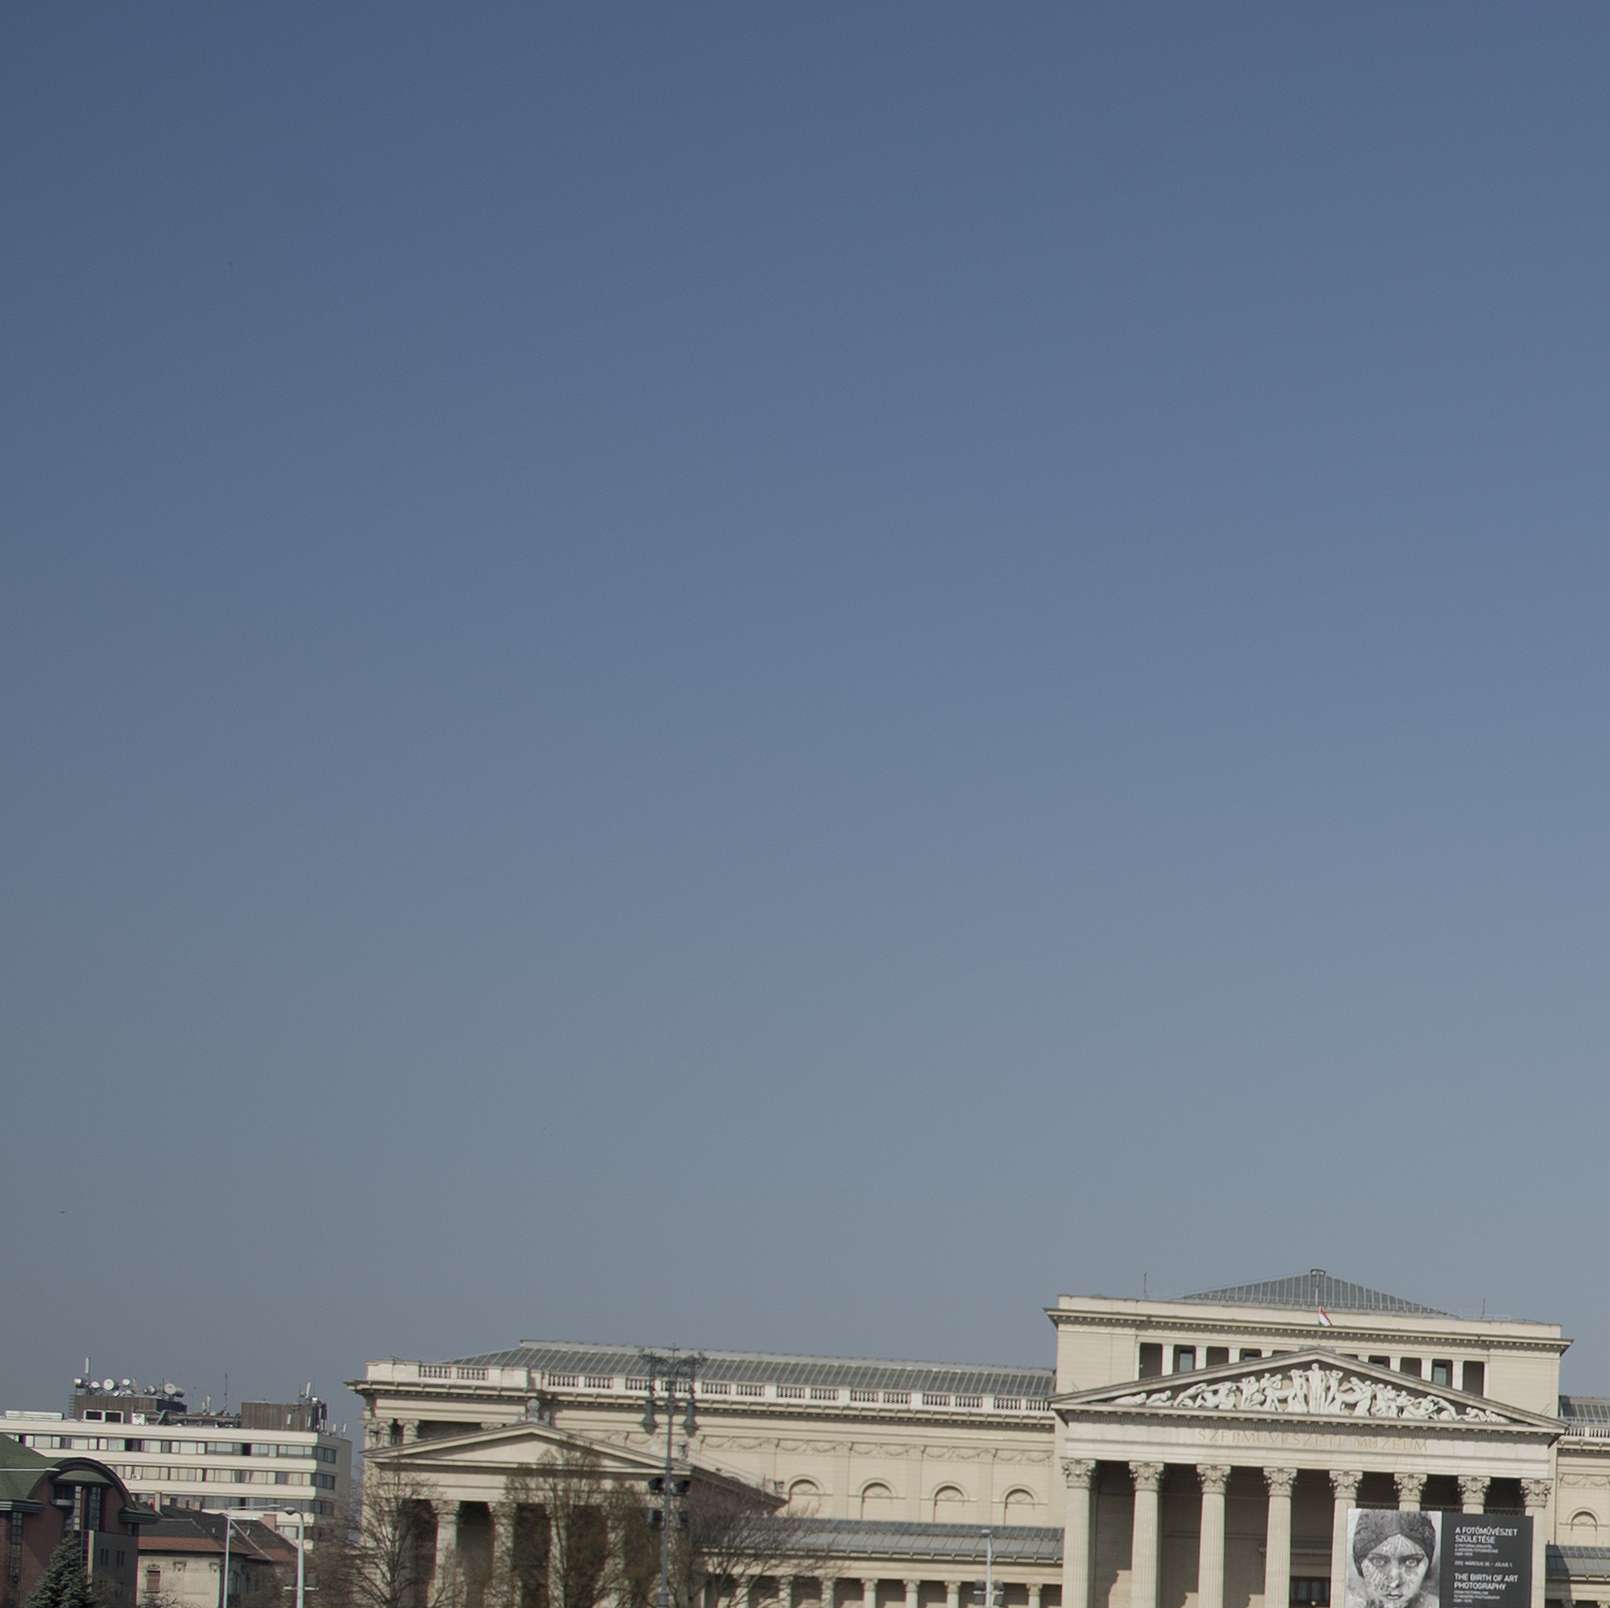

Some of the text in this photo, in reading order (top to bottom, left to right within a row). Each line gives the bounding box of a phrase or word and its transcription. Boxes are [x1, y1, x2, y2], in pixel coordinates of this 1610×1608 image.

[1455, 1526, 1461, 1534] A
[1454, 1573, 1519, 1583] THE BIRTH OF ART
[1454, 1581, 1507, 1591] PHOTOGRAPHY
